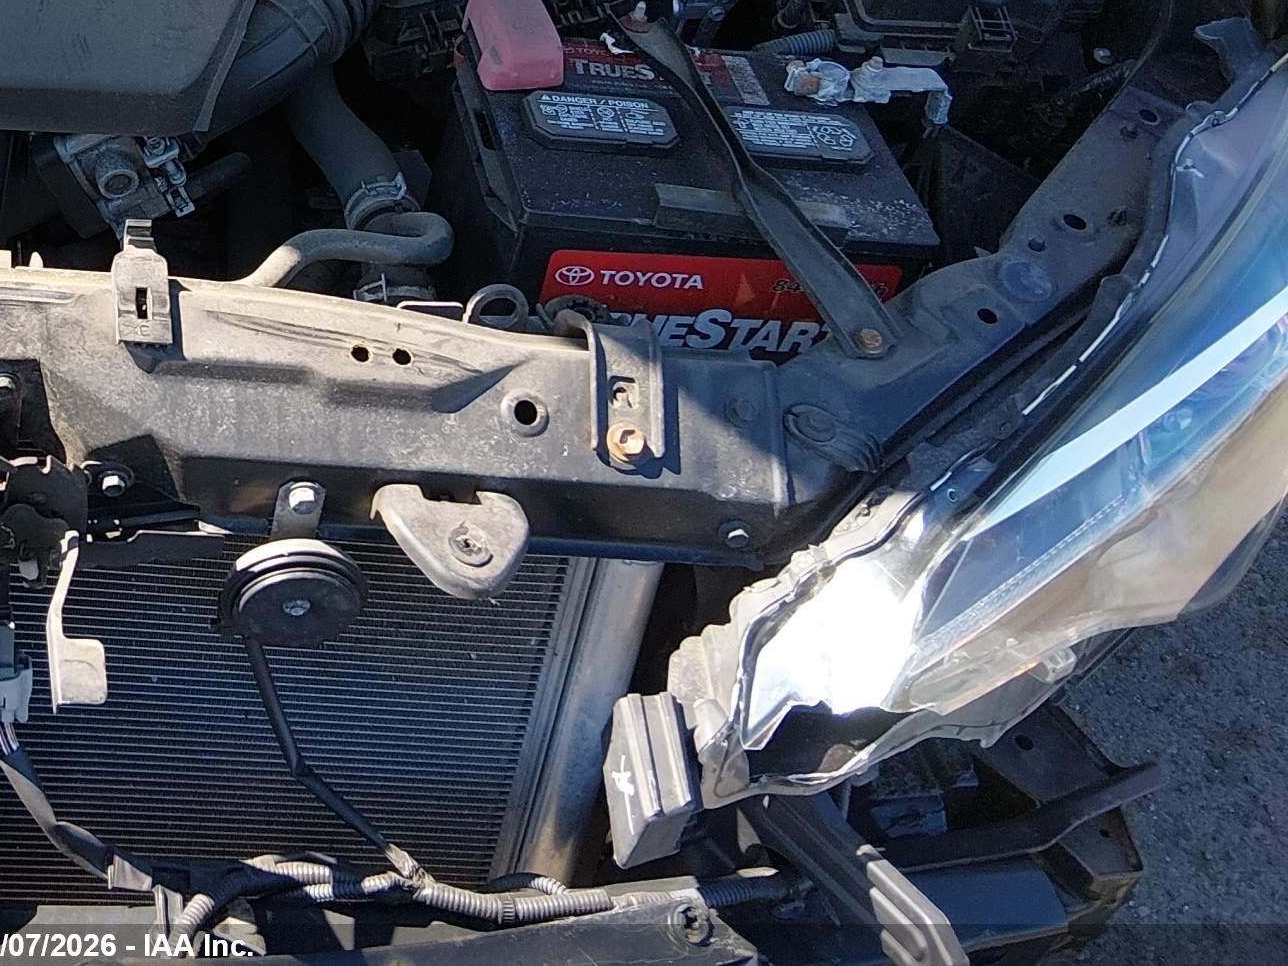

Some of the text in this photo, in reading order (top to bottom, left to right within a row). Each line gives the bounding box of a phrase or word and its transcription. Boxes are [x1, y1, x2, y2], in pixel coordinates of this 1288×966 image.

[551, 95, 597, 105] DANGER
[607, 99, 649, 109] POISON
[599, 269, 704, 290] TOYOTA
